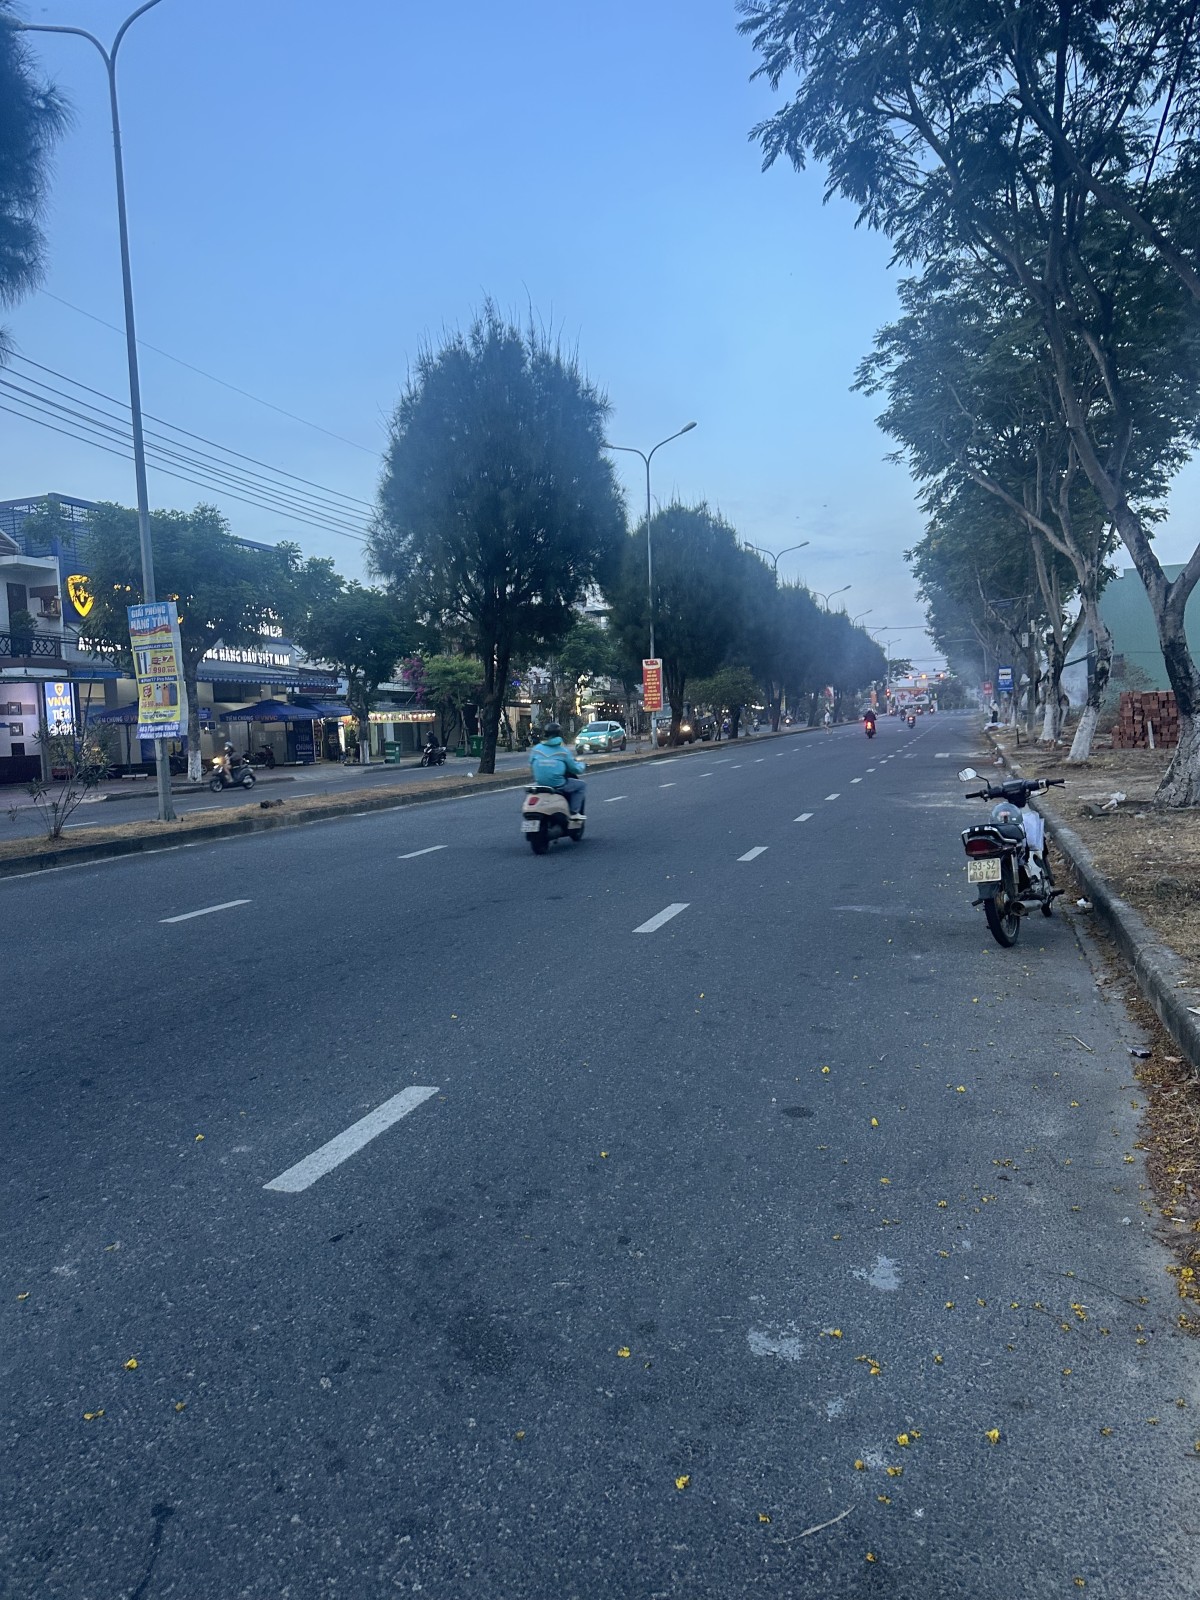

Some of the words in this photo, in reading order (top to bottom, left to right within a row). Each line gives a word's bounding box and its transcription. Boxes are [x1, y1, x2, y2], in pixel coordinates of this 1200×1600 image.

[219, 645, 241, 662] HÀNG
[241, 647, 257, 663] ĐẦU
[258, 650, 274, 668] VIỆT
[274, 653, 290, 666] NAM
[972, 859, 996, 871] 53-S2
